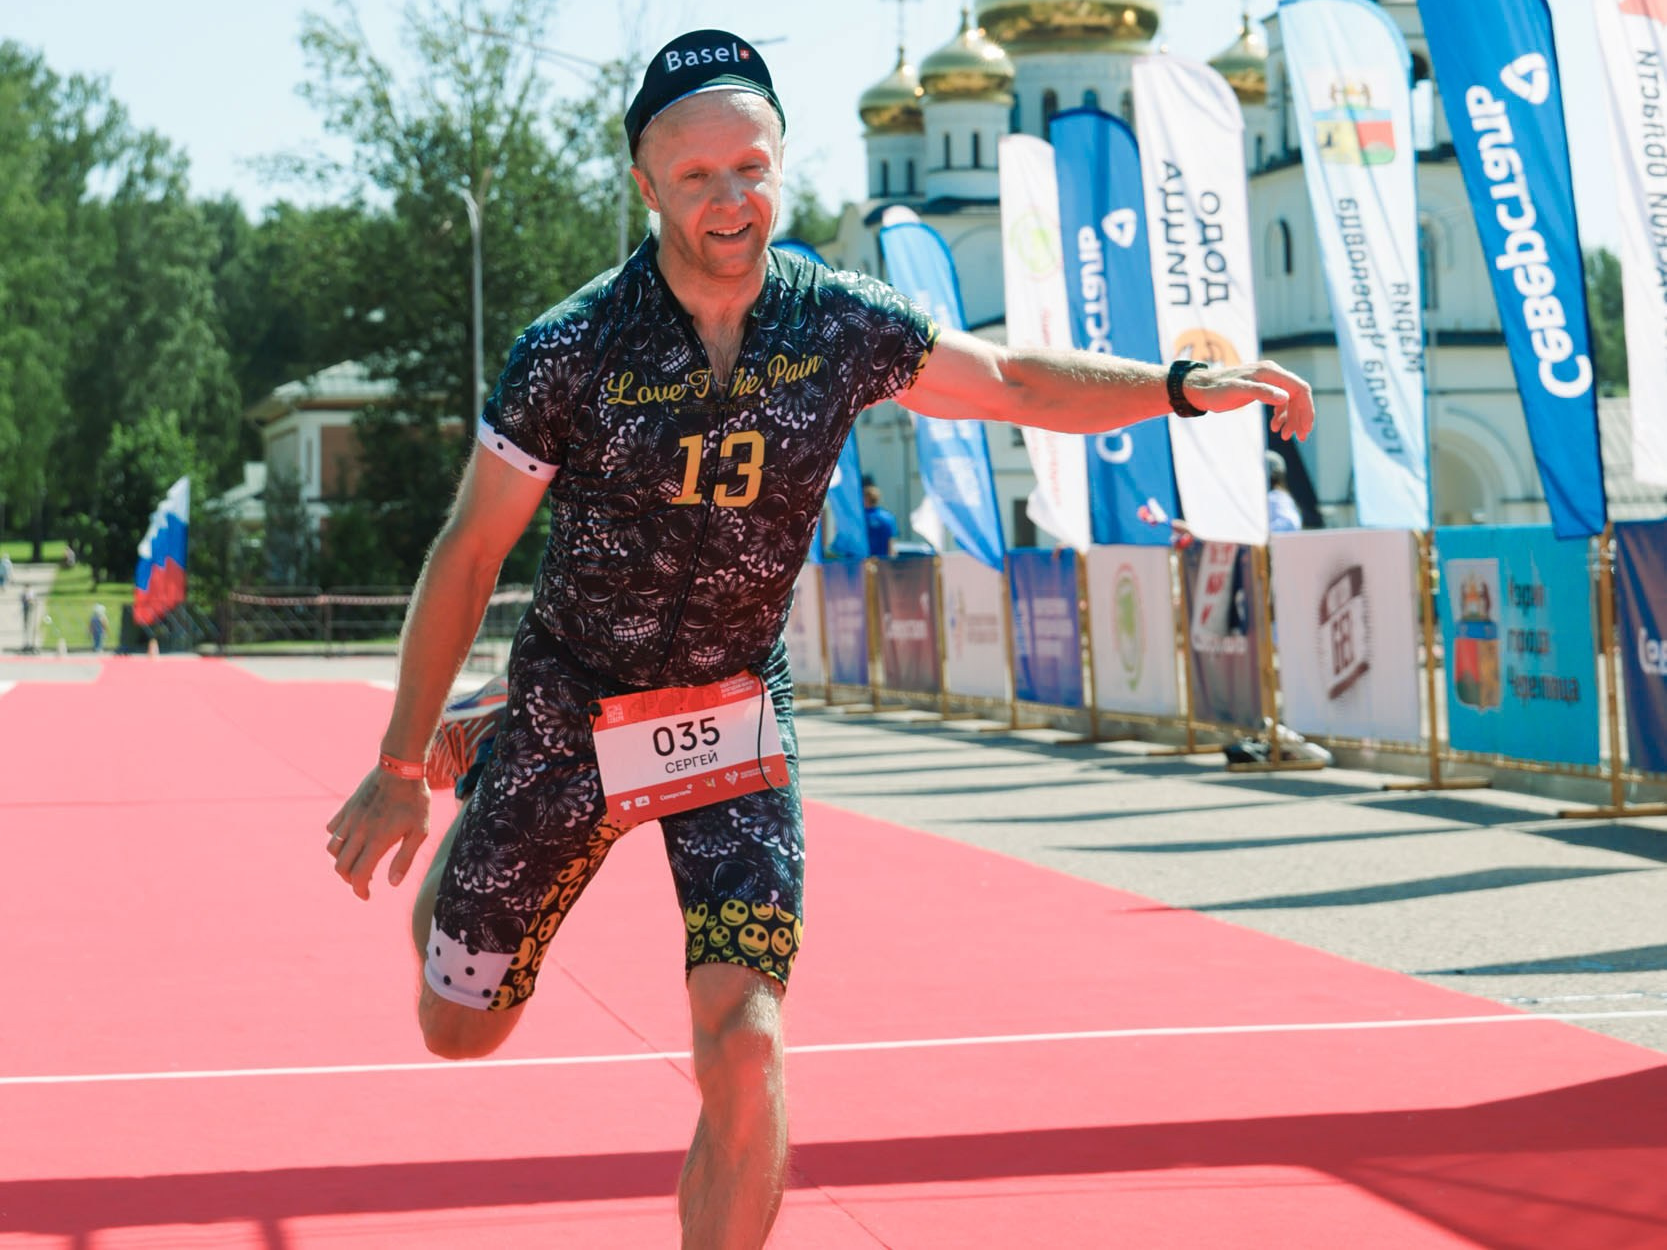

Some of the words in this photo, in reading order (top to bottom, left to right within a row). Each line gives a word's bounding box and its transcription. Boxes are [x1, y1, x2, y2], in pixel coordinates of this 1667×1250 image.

[664, 42, 740, 72] Basel
[606, 370, 687, 406] Love
[767, 353, 824, 389] Pain
[671, 430, 765, 508] 13
[652, 716, 721, 757] 035
[664, 749, 719, 774] СЕРГЕЙ
